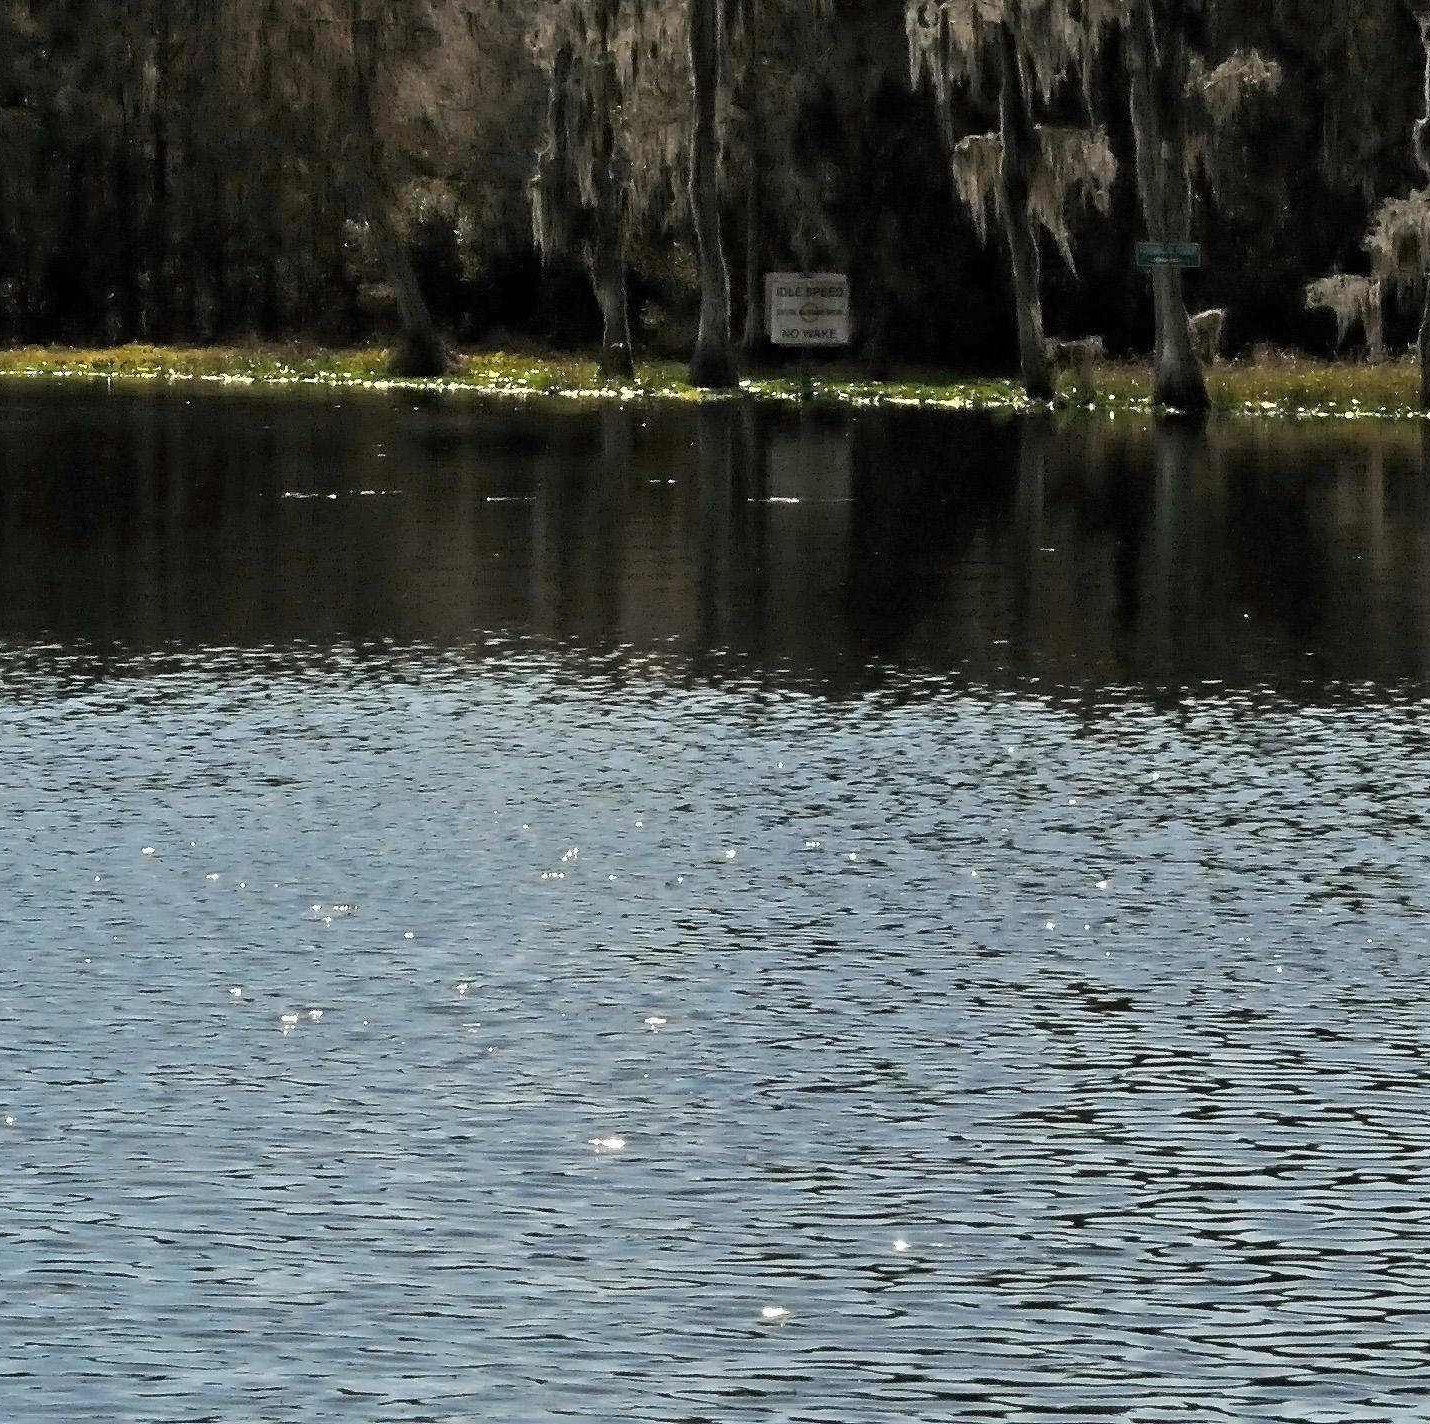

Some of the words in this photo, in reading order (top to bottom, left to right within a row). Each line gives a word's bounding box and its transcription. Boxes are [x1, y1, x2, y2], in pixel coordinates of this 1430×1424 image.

[775, 287, 802, 297] IDLE
[806, 287, 844, 297] SPEED
[781, 328, 800, 338] NO
[803, 328, 835, 339] WAKE
